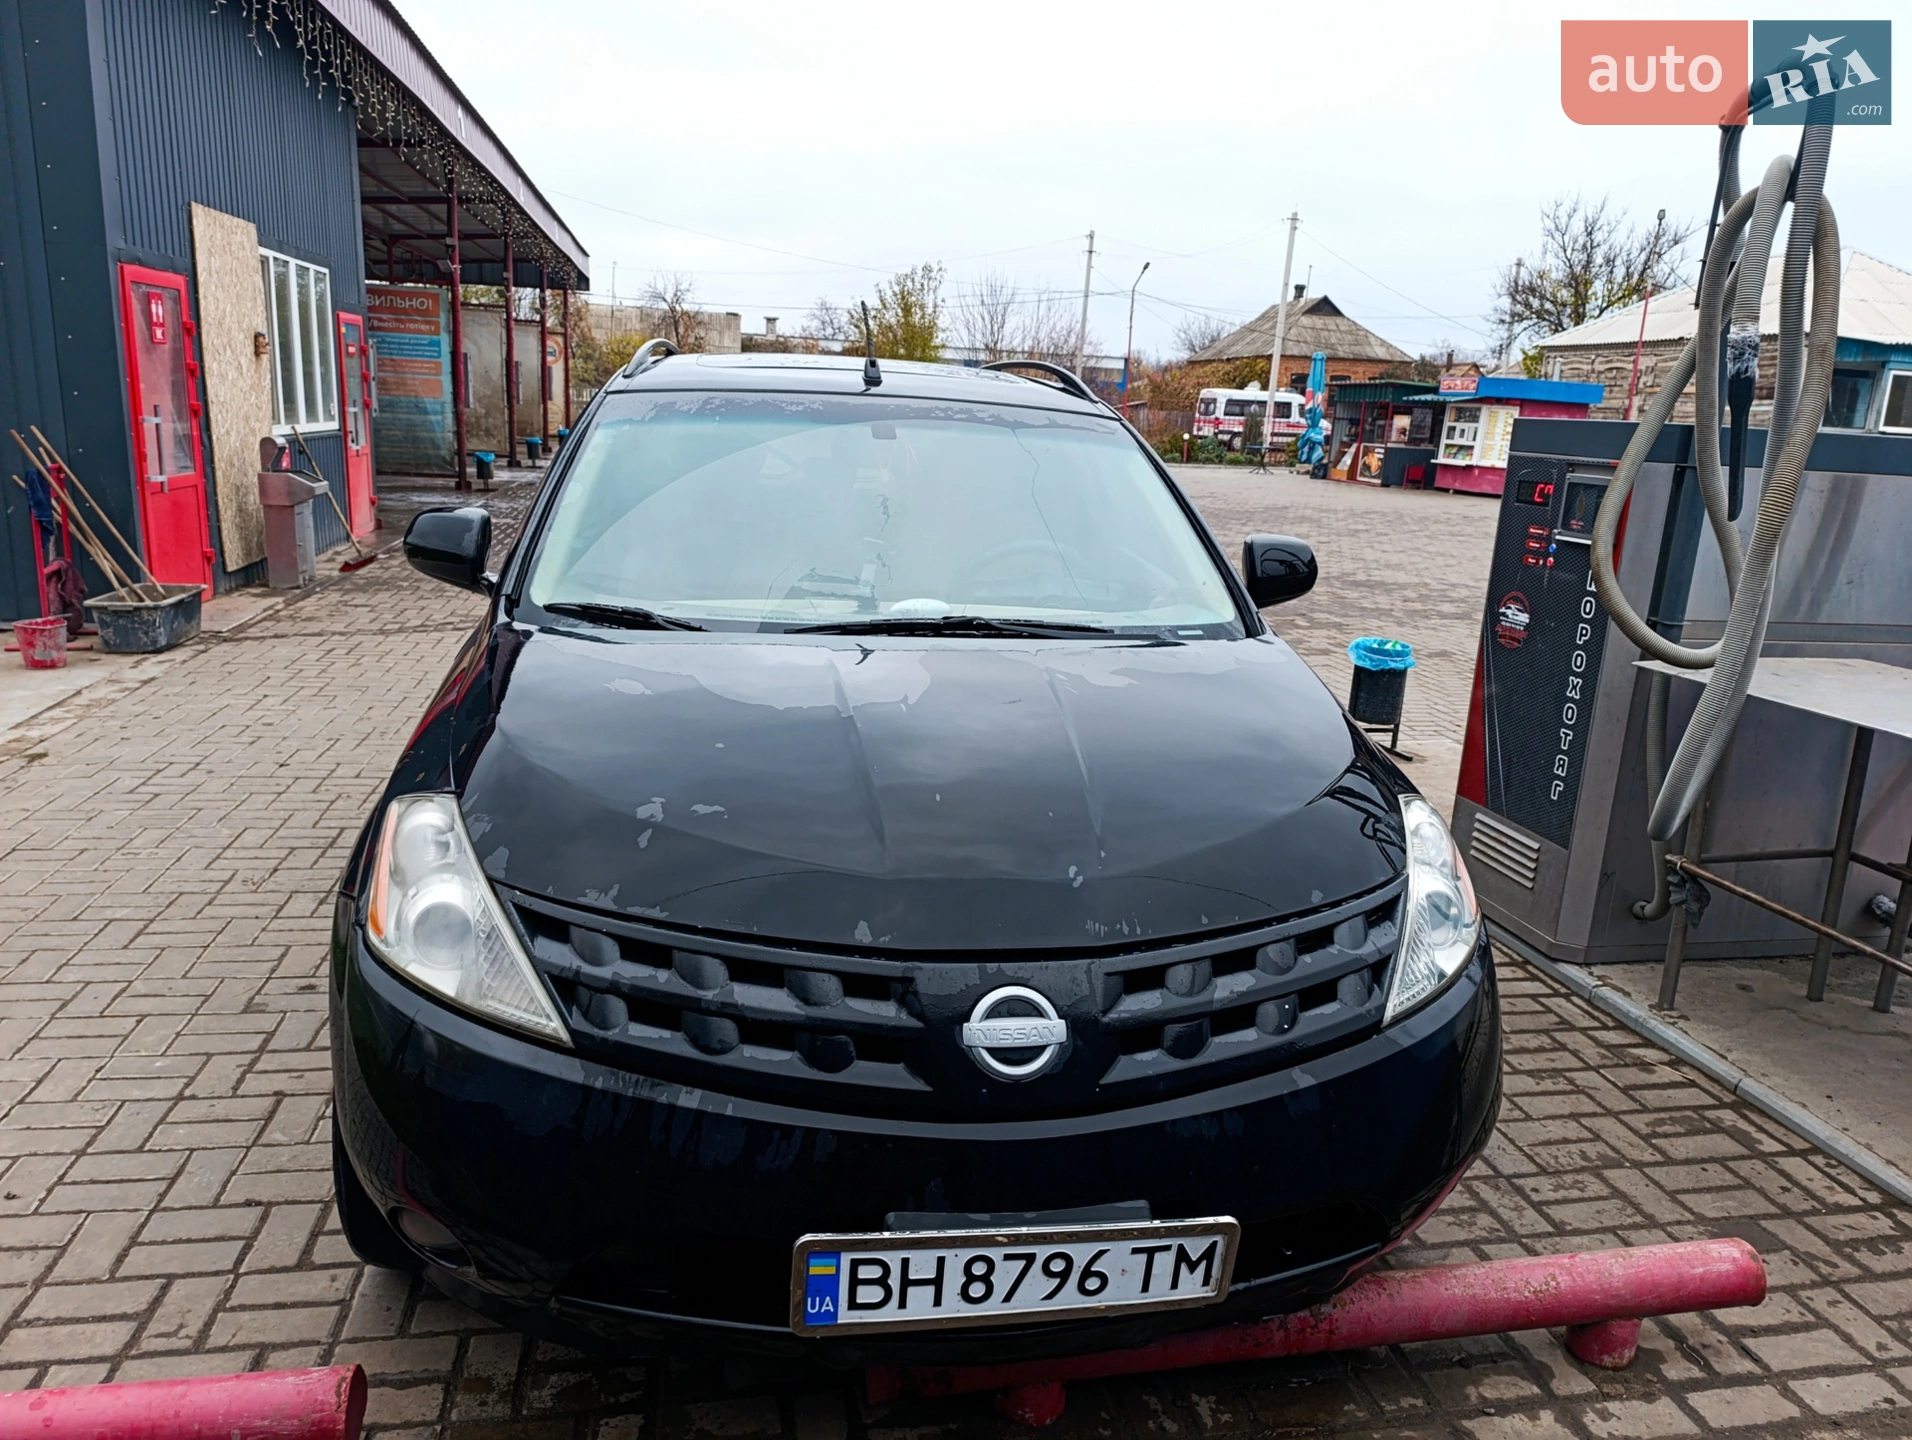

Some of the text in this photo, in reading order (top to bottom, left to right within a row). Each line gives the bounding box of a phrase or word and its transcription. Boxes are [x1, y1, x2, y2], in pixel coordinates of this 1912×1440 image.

[975, 1025, 1059, 1044] NISSAN
[847, 1239, 1219, 1312] BH 8796 TM
[807, 1296, 835, 1314] UA
